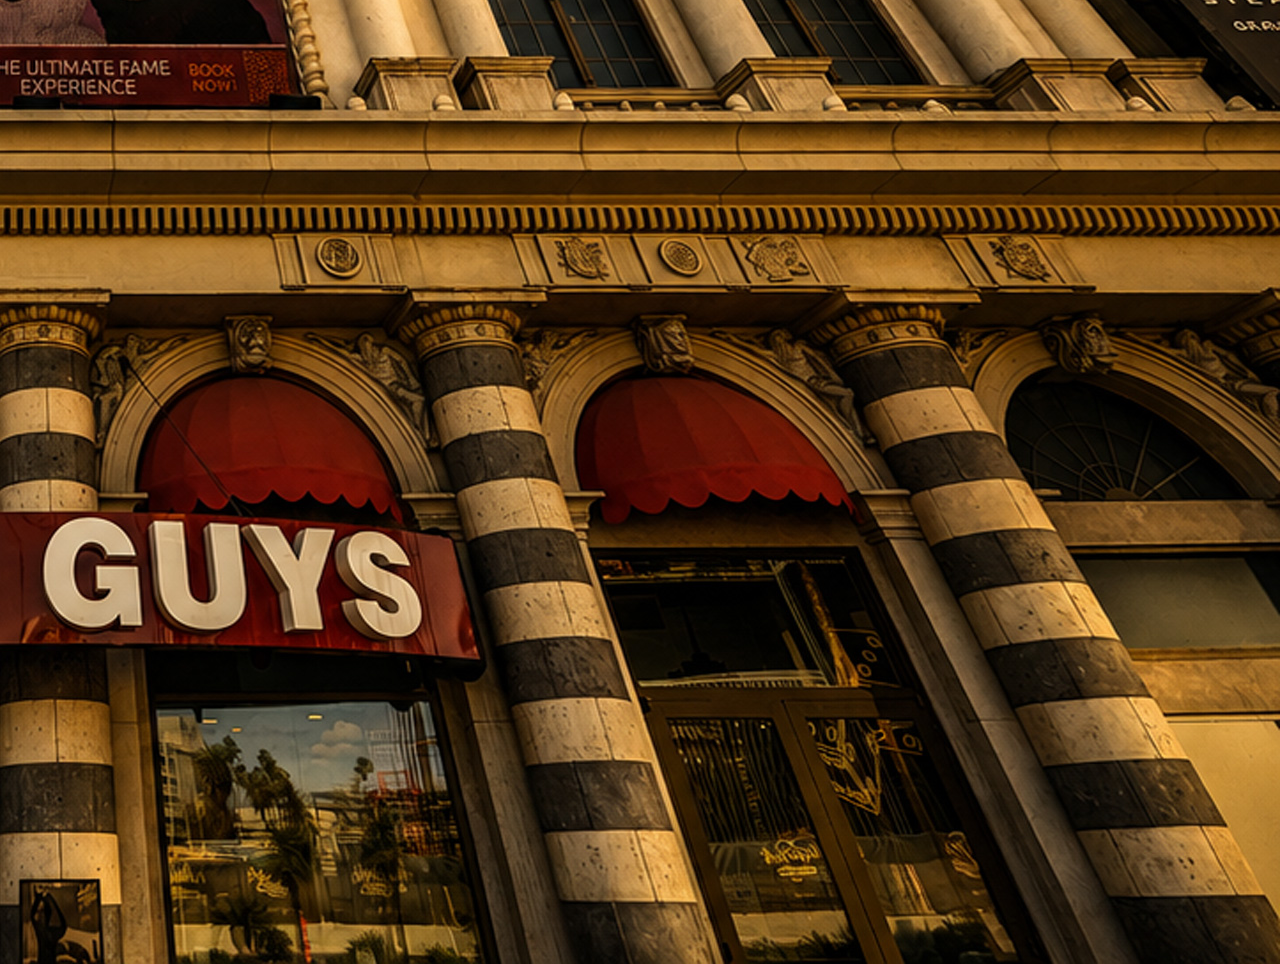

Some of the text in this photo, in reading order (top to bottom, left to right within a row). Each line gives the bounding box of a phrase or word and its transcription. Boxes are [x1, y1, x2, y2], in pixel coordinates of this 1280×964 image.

[25, 59, 115, 76] ULTIMATE
[119, 59, 171, 76] FAME
[188, 62, 235, 77] BOOK
[20, 78, 137, 96] EXPERIENCE
[42, 516, 423, 639] GUYS
